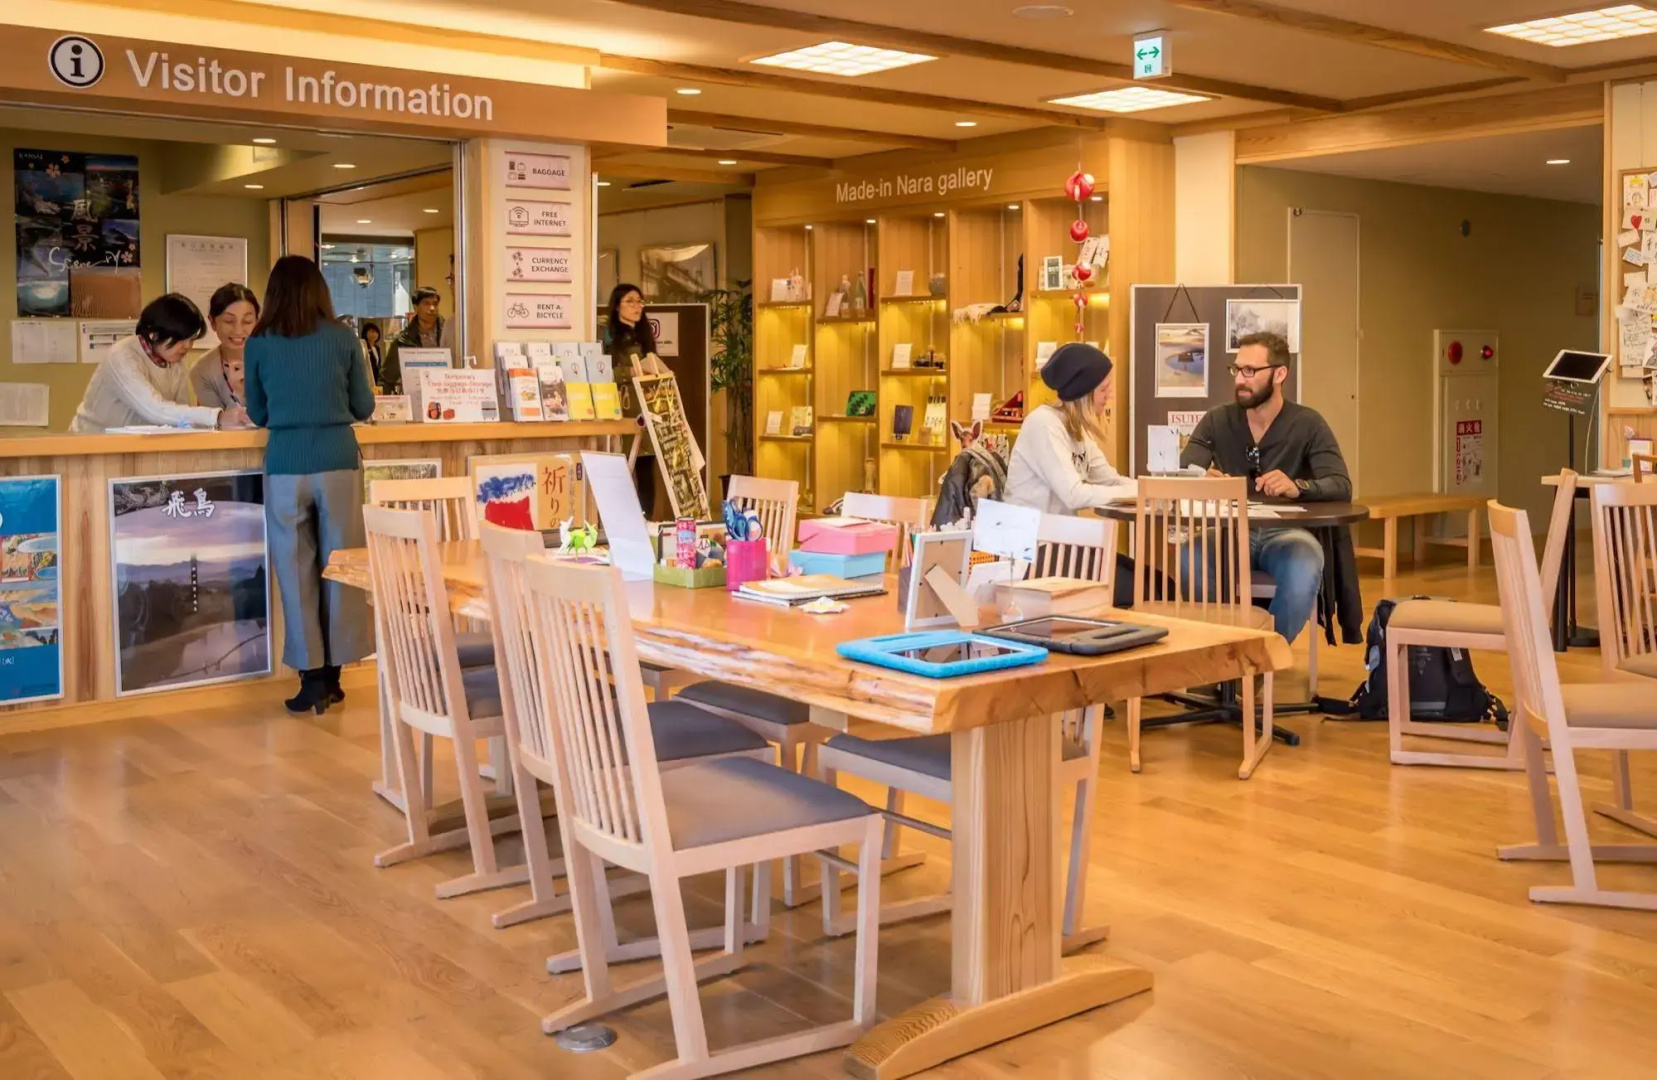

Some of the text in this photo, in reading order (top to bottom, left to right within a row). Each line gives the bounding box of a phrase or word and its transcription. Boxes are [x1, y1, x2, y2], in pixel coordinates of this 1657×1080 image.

[125, 49, 266, 98] Visitor
[285, 66, 493, 121] Information
[532, 167, 567, 177] BAGGAGE
[836, 167, 993, 203] Made-in Nara gallery
[71, 199, 100, 251] 風景
[533, 219, 567, 227] INTERNET
[531, 257, 569, 265] CURRENCY
[531, 265, 569, 273] EXCHANGE
[162, 487, 215, 518] 飛鳥
